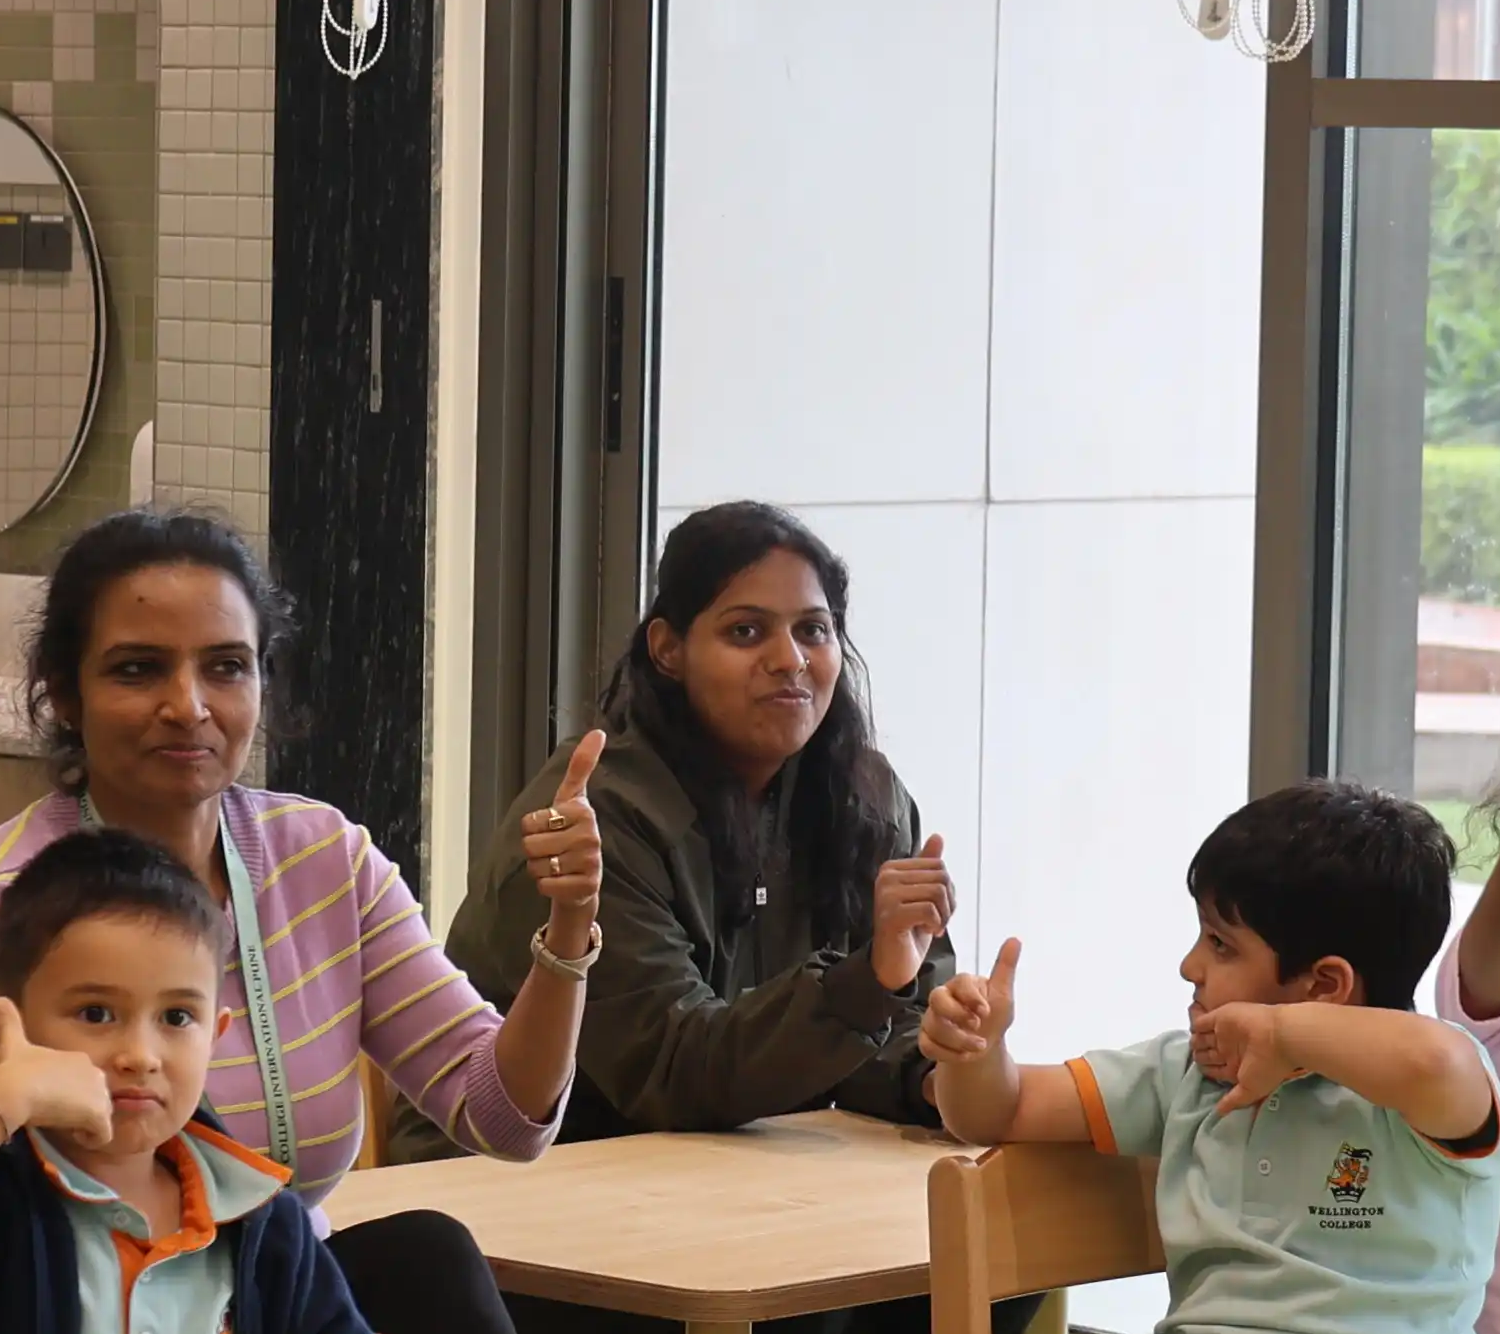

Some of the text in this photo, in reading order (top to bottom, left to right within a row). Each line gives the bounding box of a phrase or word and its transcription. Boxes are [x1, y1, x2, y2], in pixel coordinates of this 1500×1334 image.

[247, 945, 262, 982] PUNE
[254, 983, 283, 1098] INTERNATIONAL
[1308, 1205, 1384, 1216] WELLINGTON
[1319, 1219, 1372, 1229] COLLEGE
